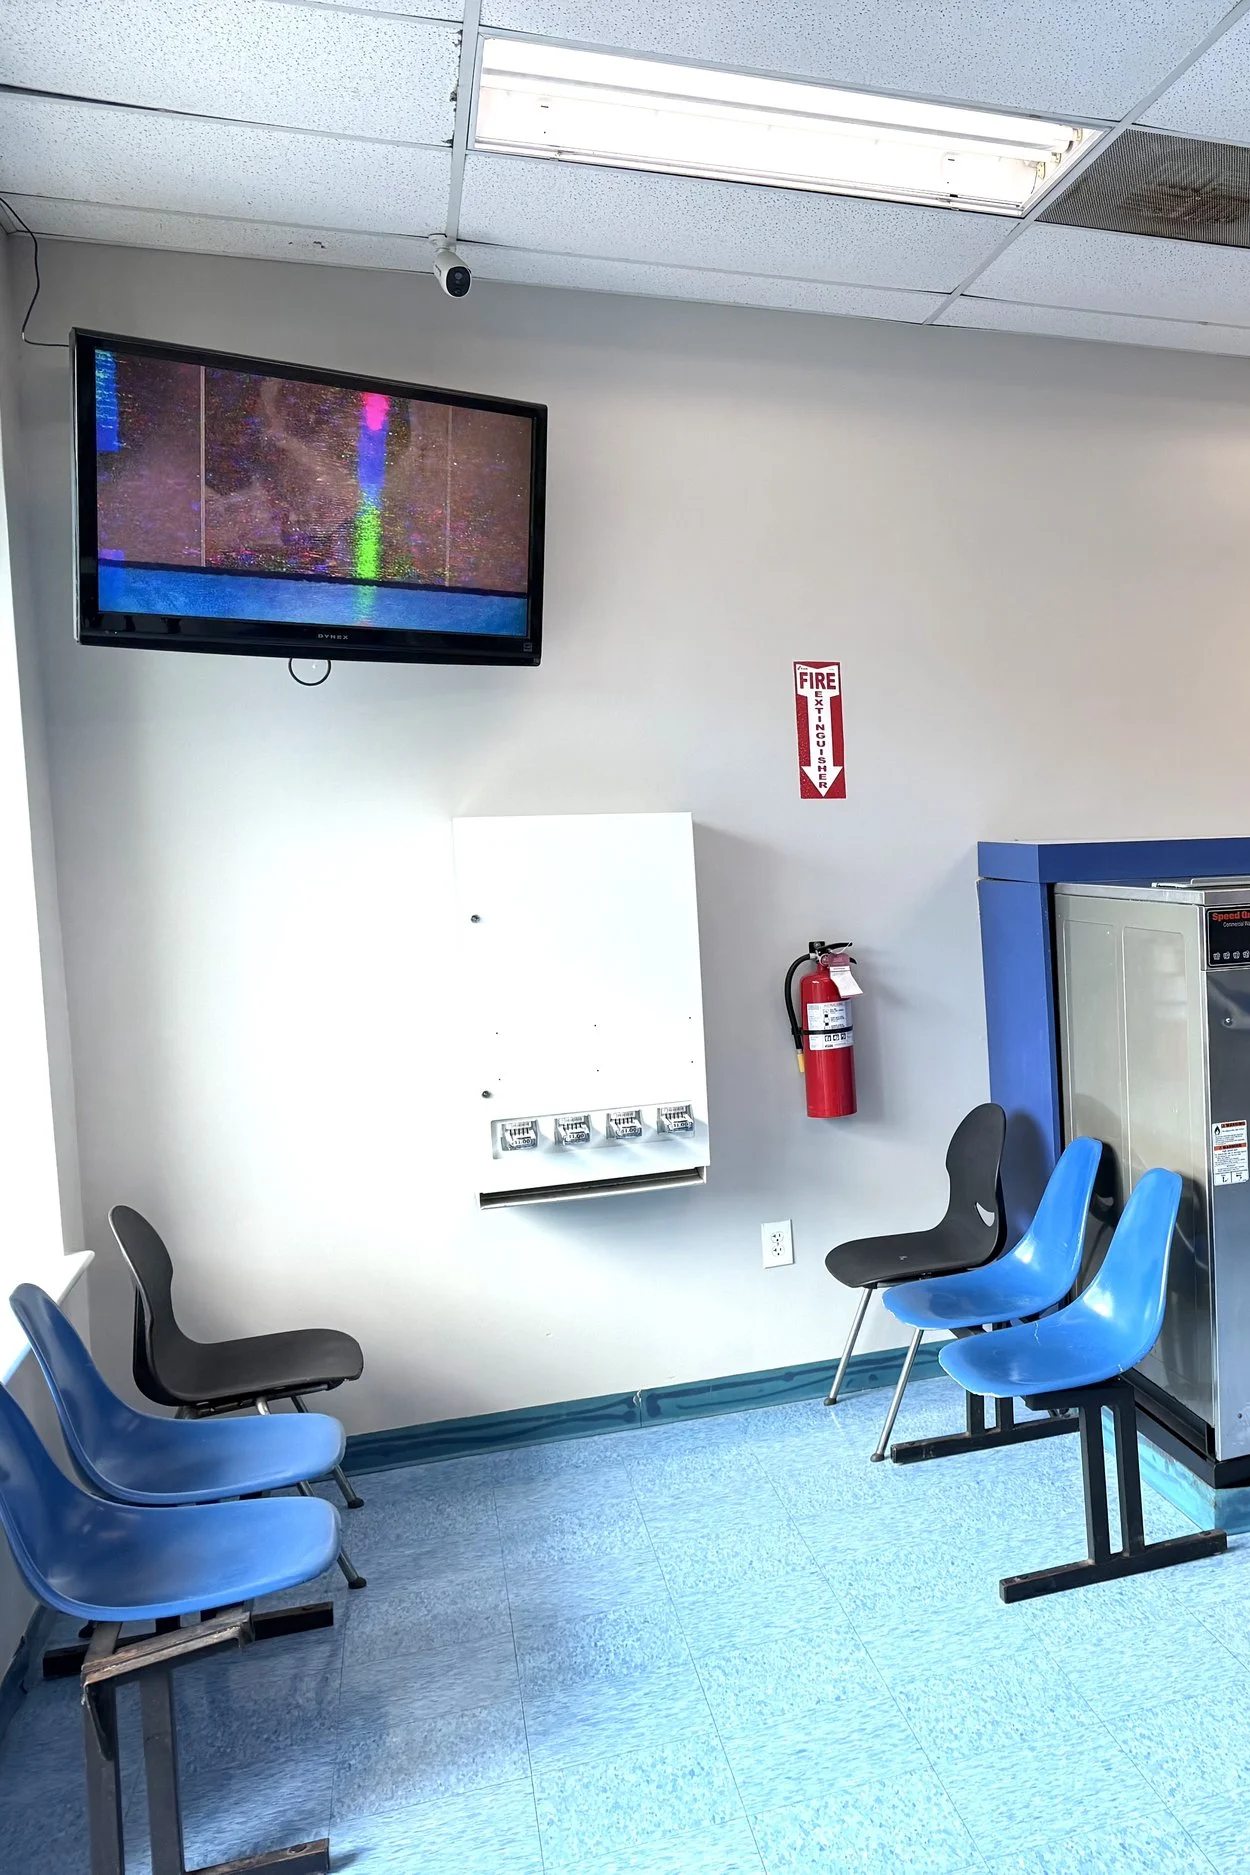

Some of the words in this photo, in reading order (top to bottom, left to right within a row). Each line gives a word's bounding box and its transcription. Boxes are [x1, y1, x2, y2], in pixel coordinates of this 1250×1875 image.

[800, 672, 836, 690] FIRE
[814, 690, 828, 788] EXTINGUISHER
[1212, 912, 1240, 921] Speed
